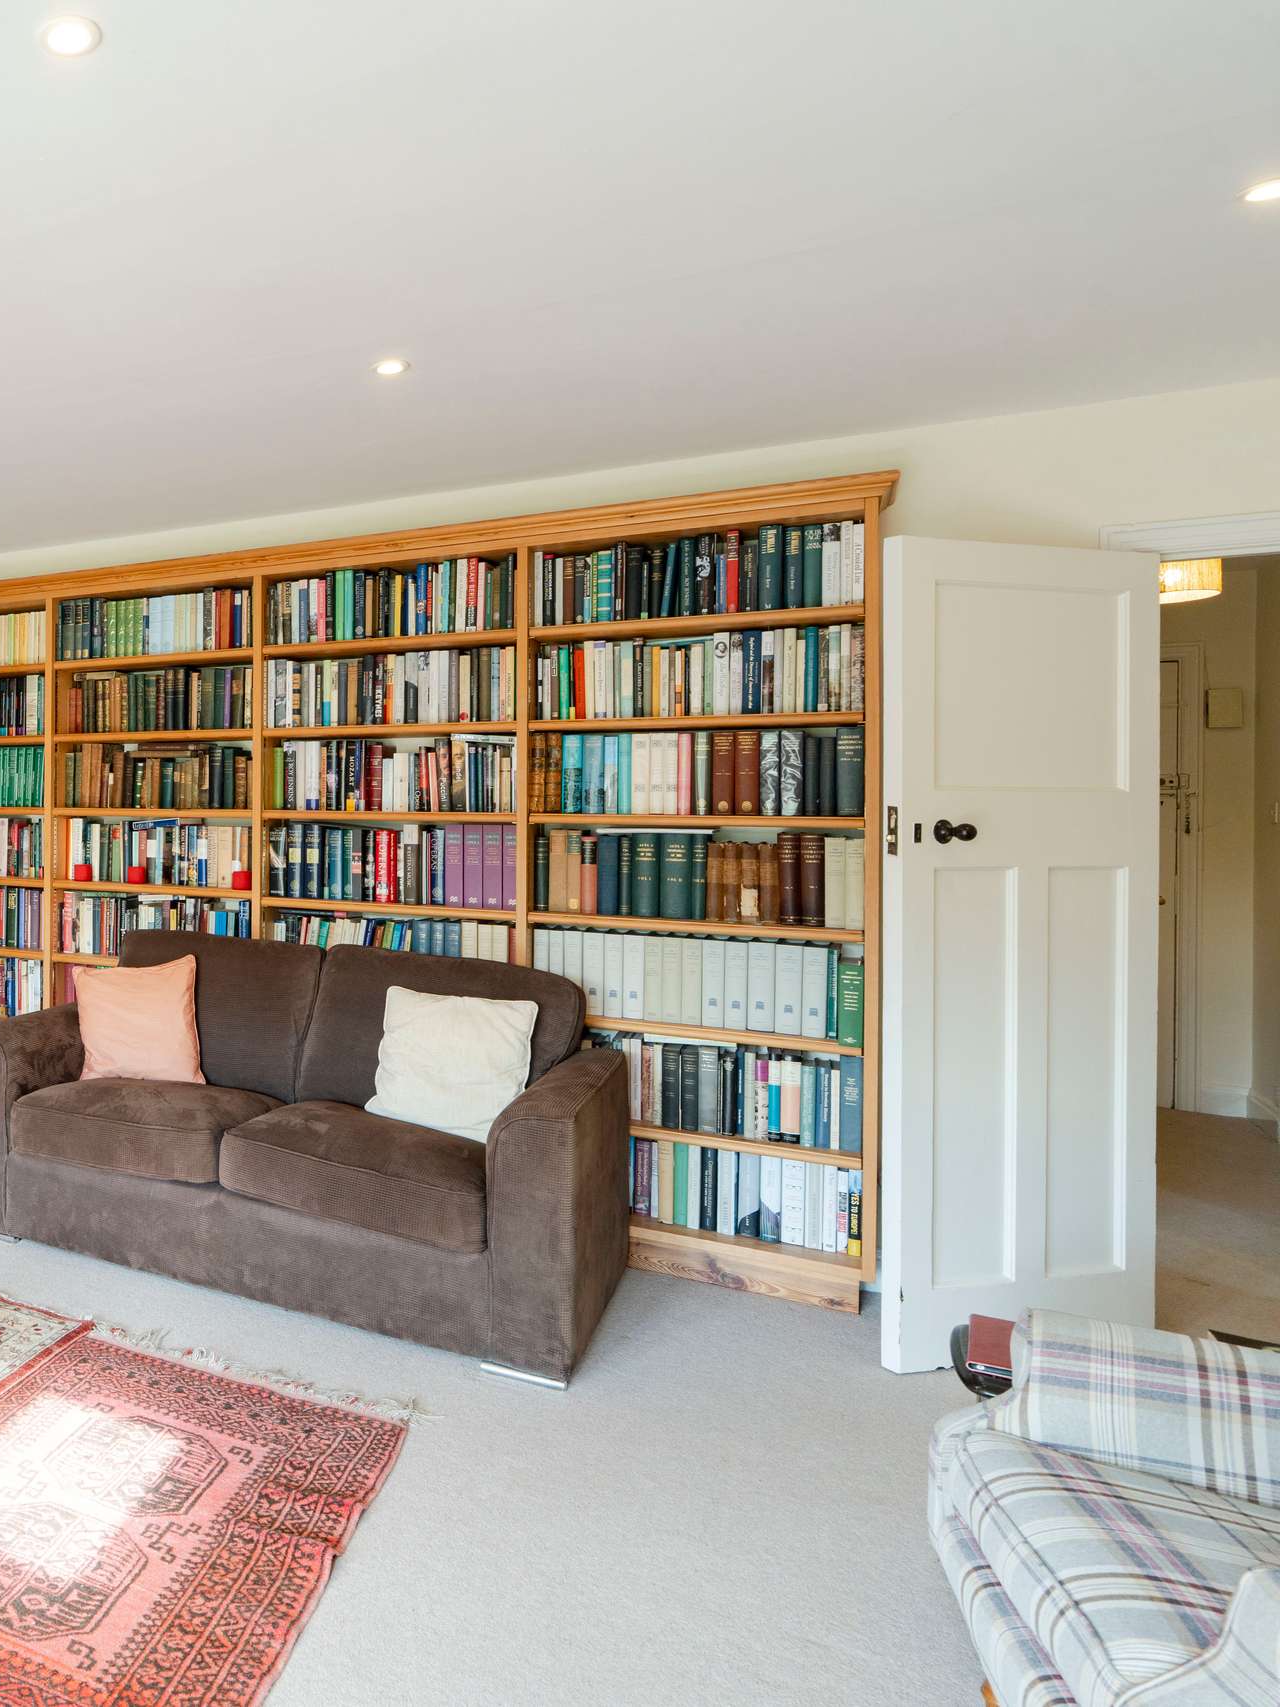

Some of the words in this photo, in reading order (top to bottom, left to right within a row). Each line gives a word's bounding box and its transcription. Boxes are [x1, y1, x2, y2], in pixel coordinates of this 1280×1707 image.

[468, 558, 476, 583] ISAIAH
[468, 584, 476, 607] BERLIN
[287, 776, 295, 802] JENKINS
[439, 777, 447, 802] Puccini
[378, 844, 386, 875] OPERA
[851, 1192, 859, 1205] YES
[850, 1214, 858, 1235] EUROPE!
